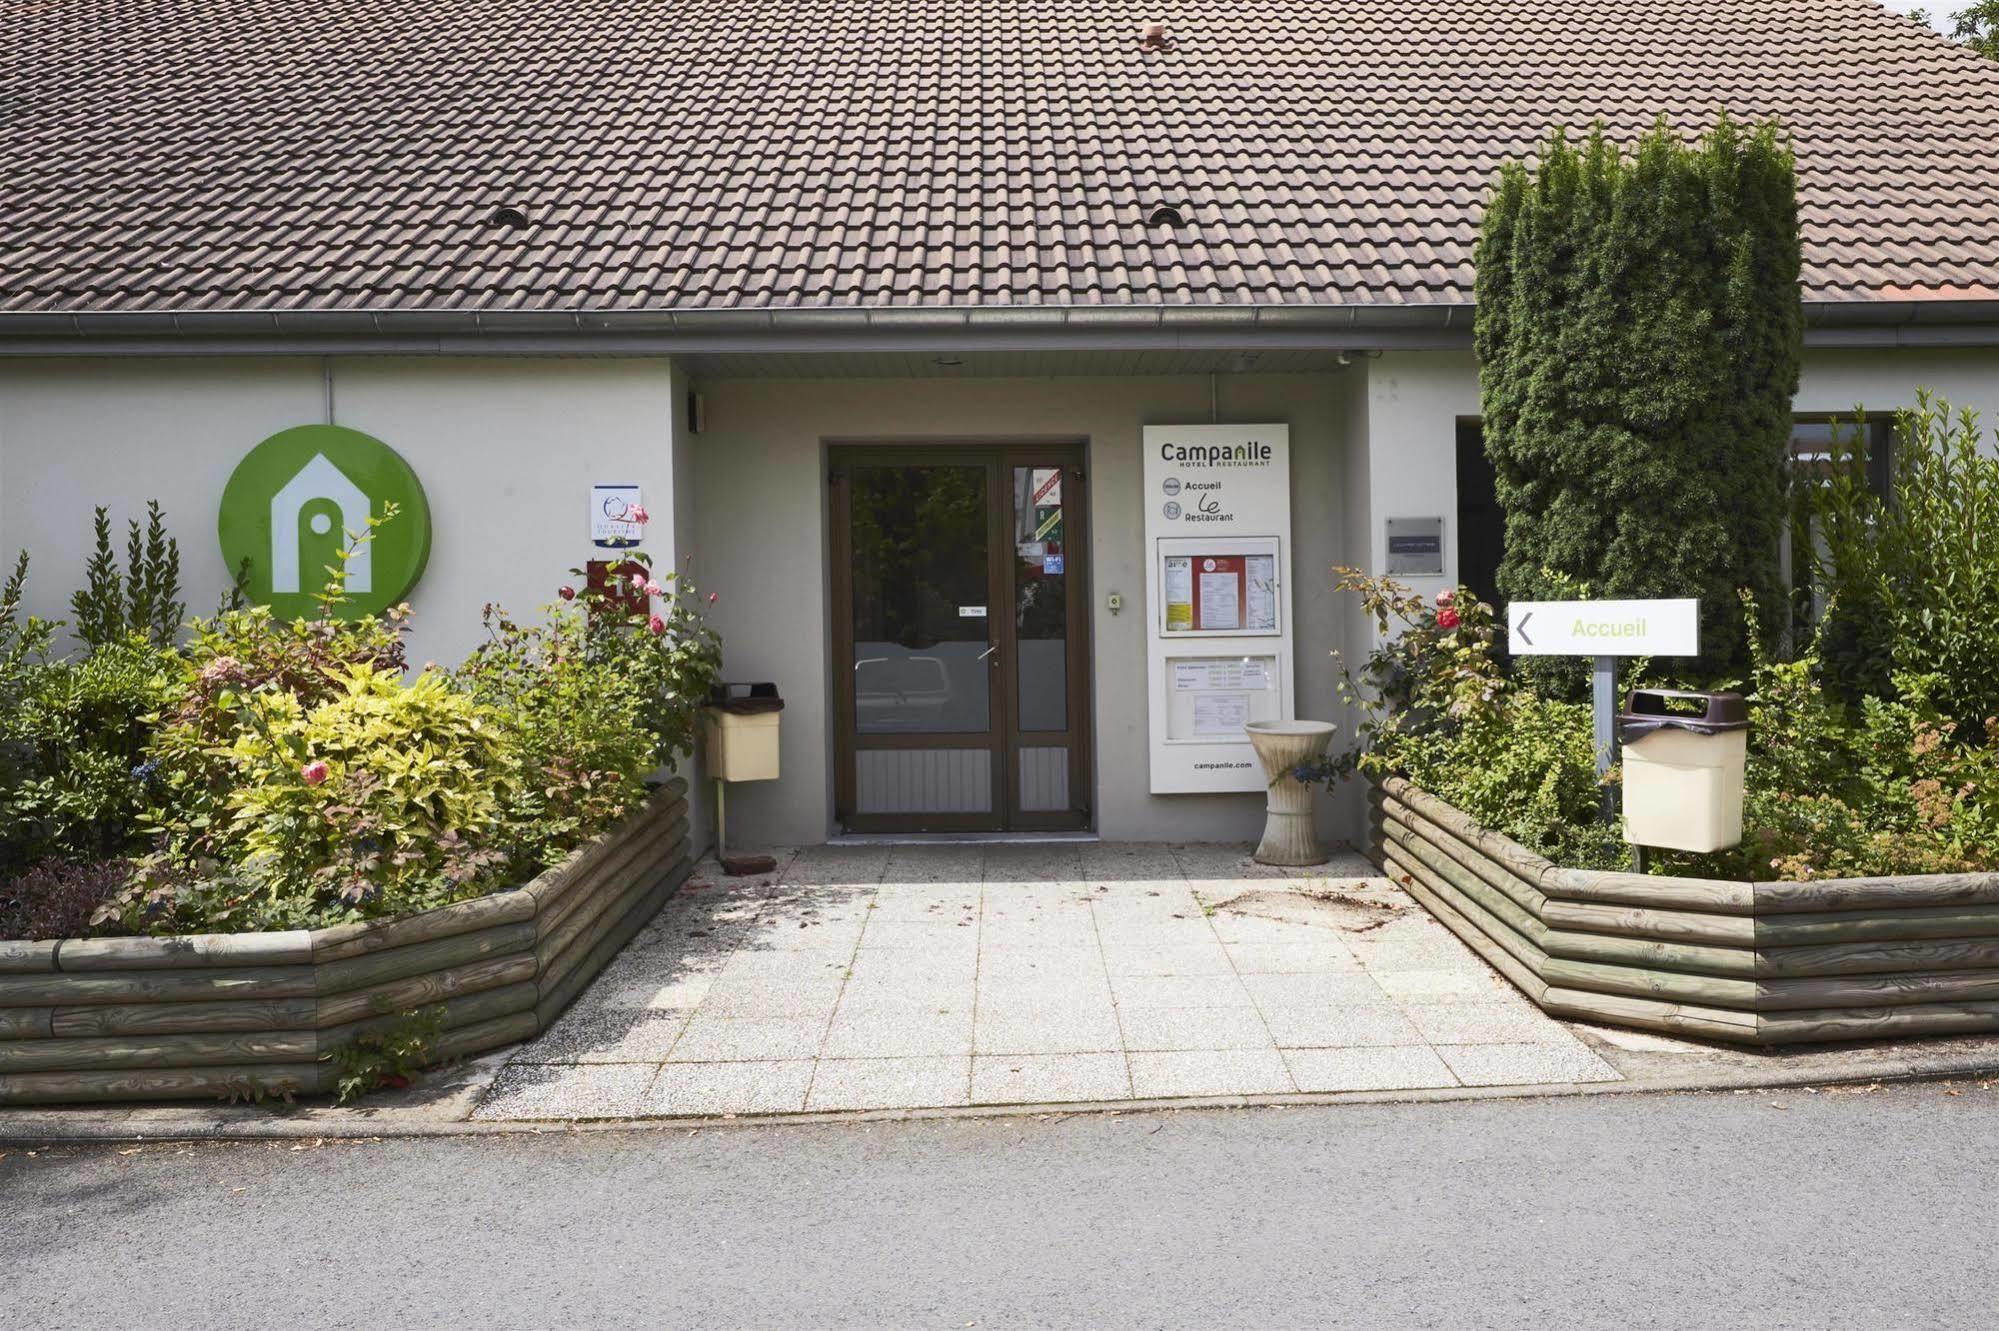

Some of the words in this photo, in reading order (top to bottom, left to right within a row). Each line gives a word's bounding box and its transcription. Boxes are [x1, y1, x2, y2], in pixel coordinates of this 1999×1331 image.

[1161, 441, 1272, 467] Campanile
[1185, 482, 1221, 490] Accueil
[1185, 513, 1233, 522] Restaurant
[1571, 618, 1647, 637] Accueil
[1194, 762, 1252, 770] campanile.com
